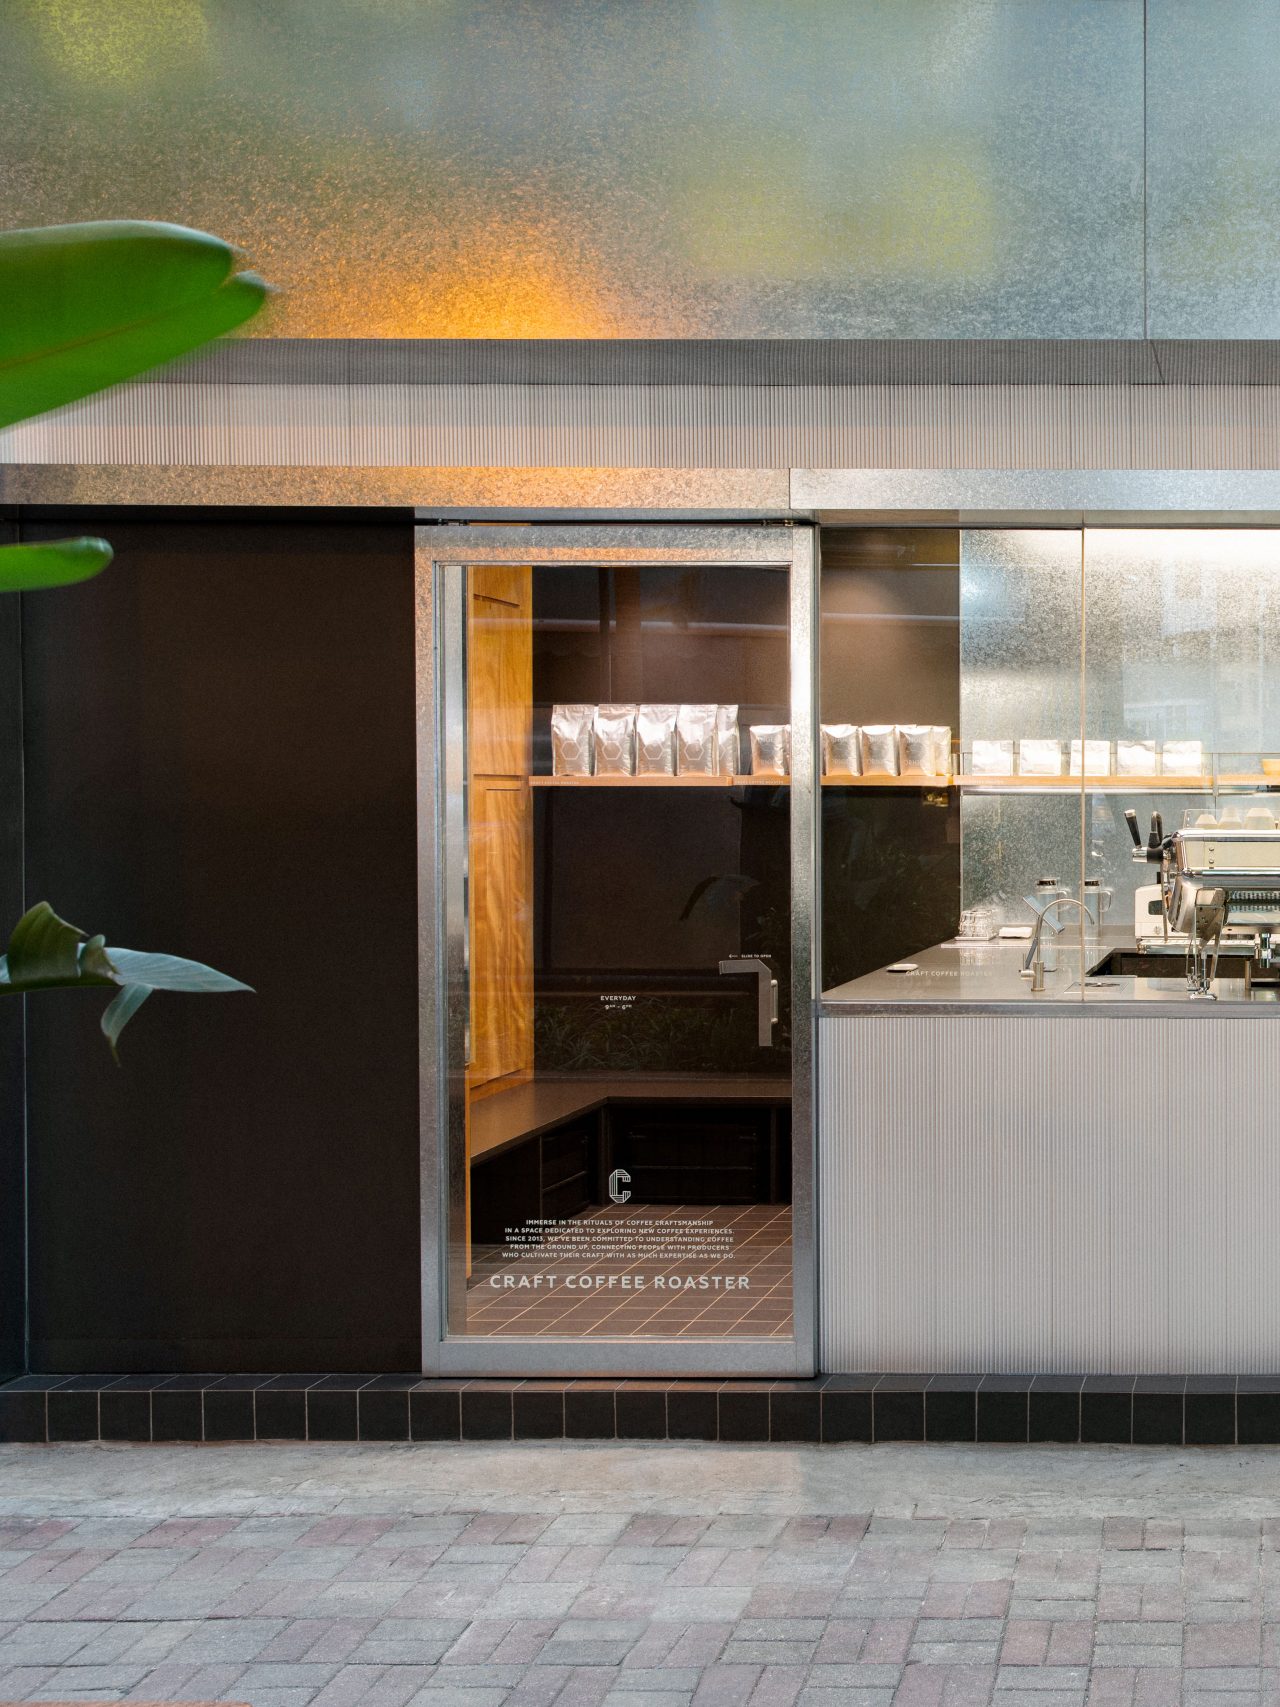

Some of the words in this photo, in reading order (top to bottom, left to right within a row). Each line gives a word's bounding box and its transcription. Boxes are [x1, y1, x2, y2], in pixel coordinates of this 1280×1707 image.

[490, 1275, 557, 1289] CRAFT
[565, 1275, 645, 1289] COFFEE
[654, 1276, 750, 1289] ROASTER
